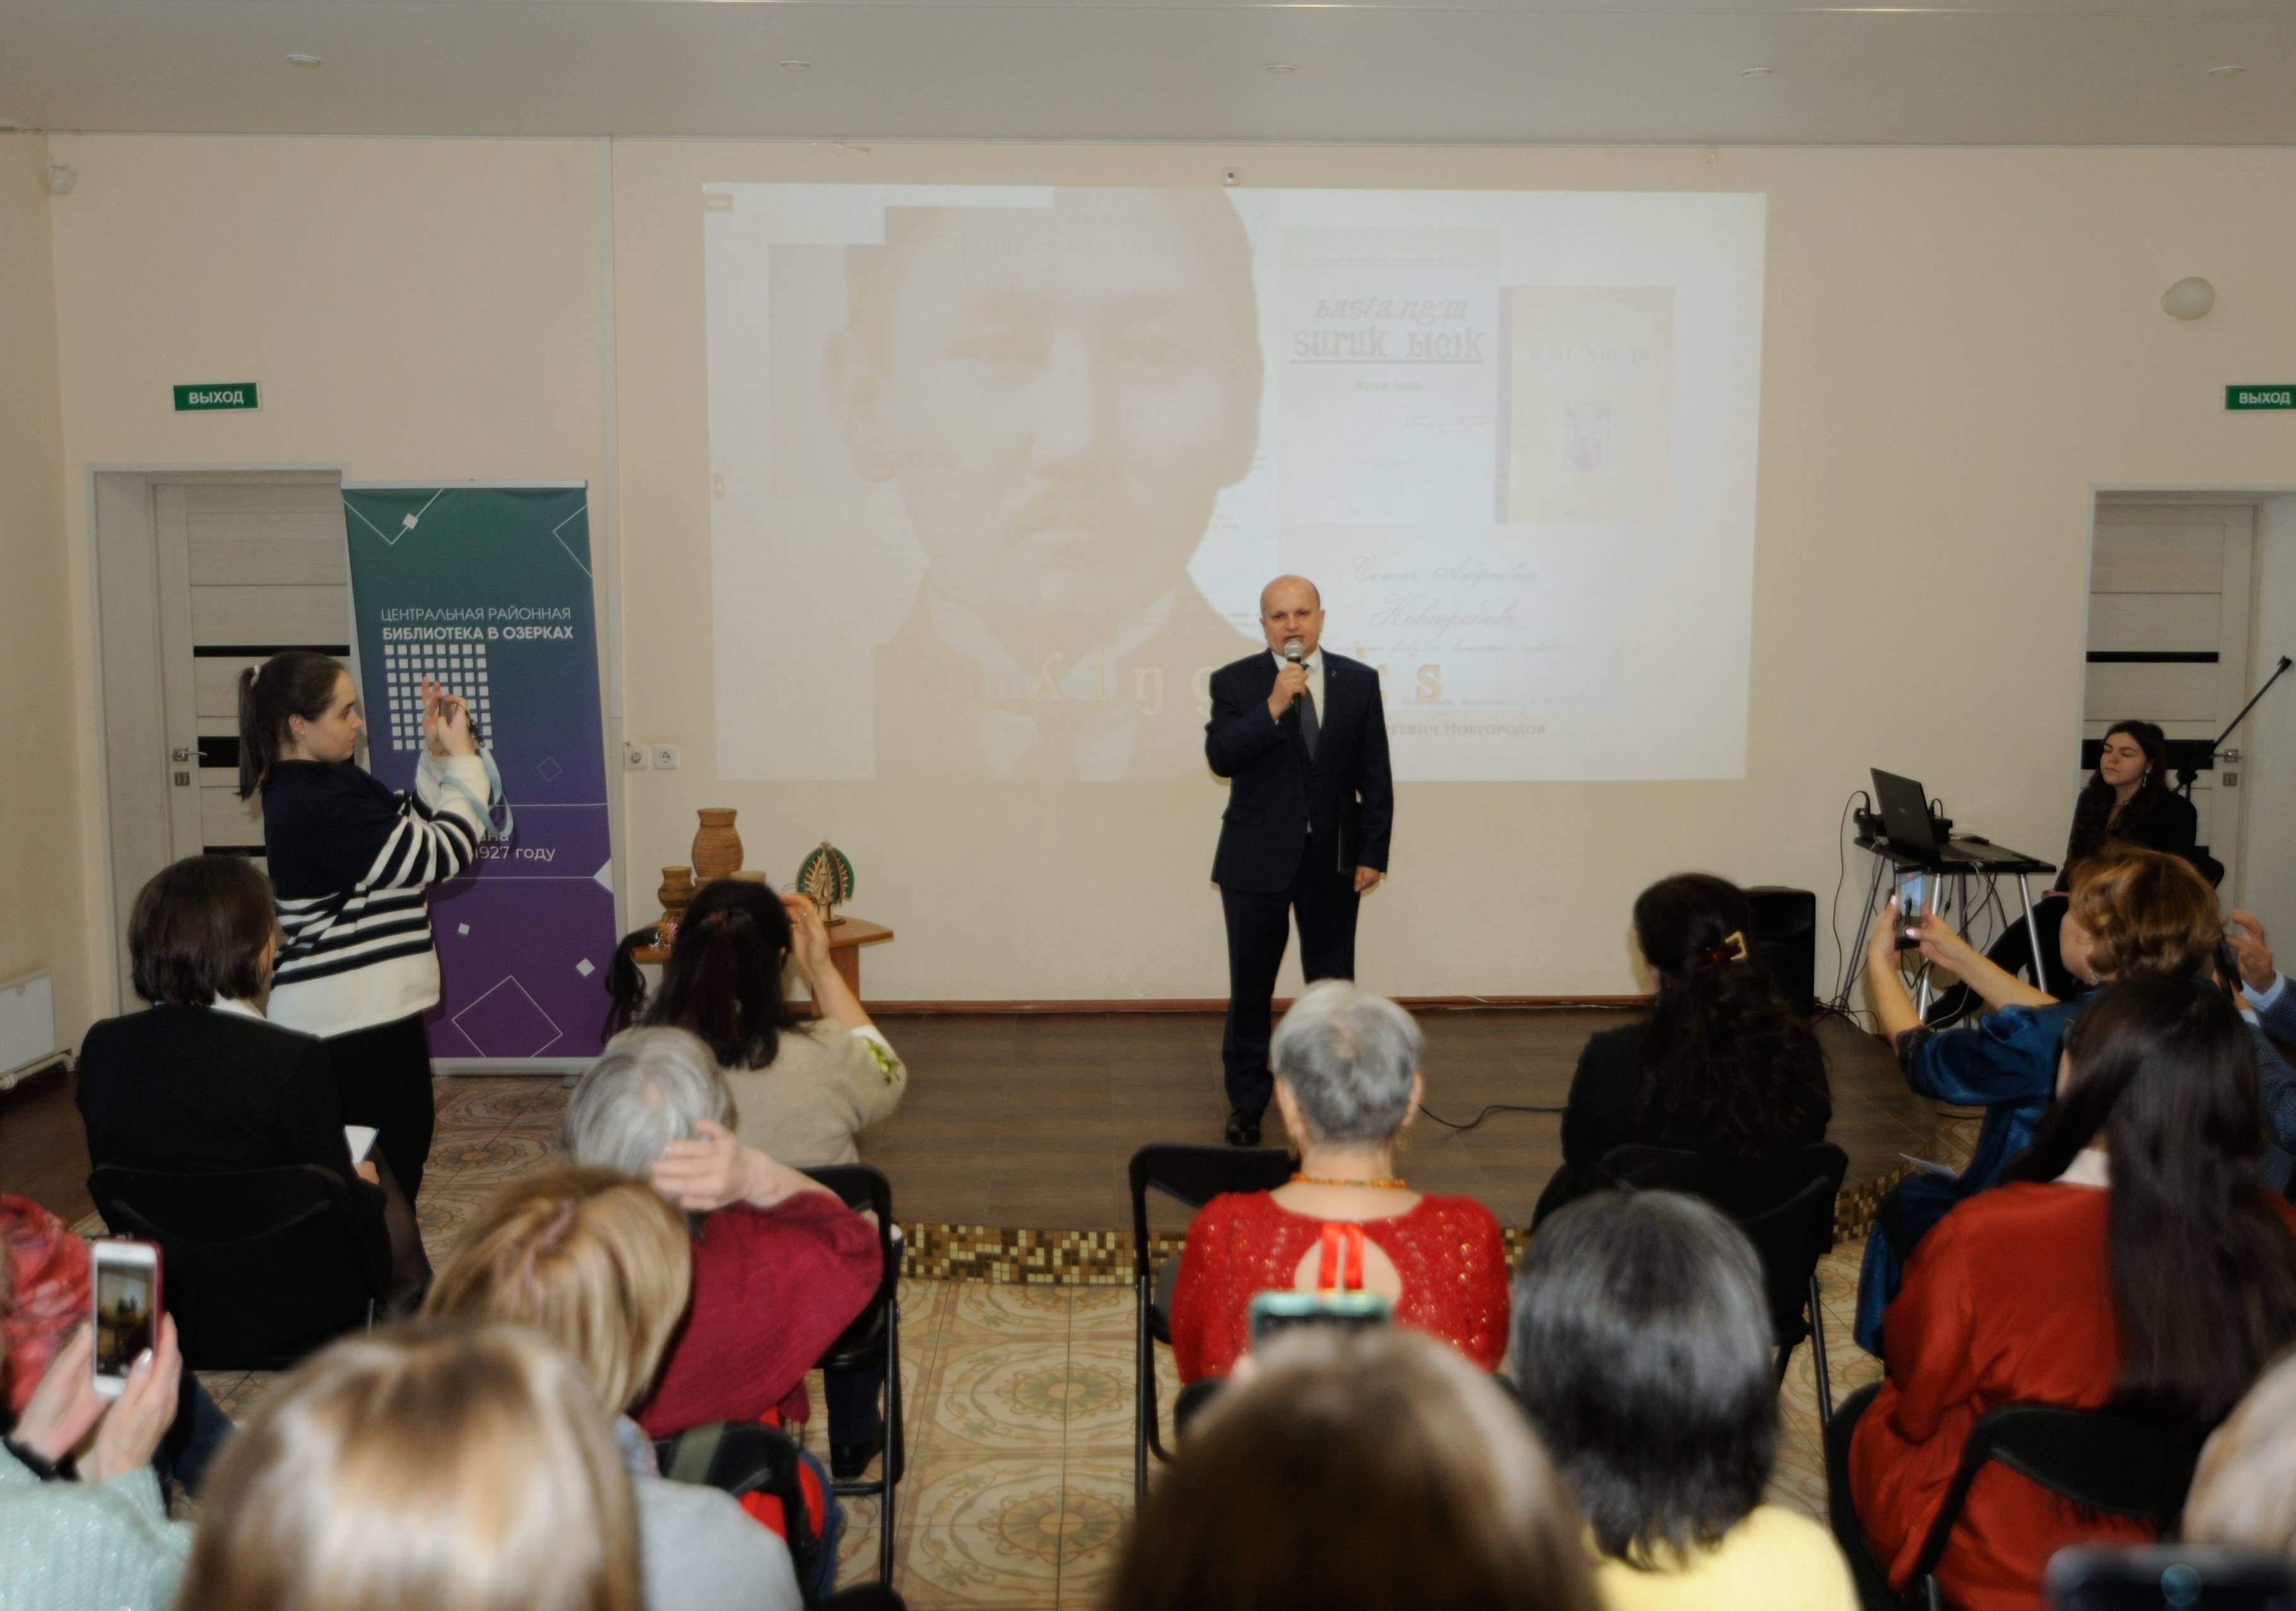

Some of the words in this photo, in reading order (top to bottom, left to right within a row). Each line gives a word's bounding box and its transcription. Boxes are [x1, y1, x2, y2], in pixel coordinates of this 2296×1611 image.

[189, 390, 244, 405] ВЫХОД
[2239, 392, 2291, 405] ВЫХОД
[381, 608, 484, 622] ЦЕНТРАЛЬНАЯ
[488, 606, 571, 620] РАЙОННАЯ
[383, 627, 484, 640] БИБЛИОТЕКА
[488, 627, 499, 640] В
[503, 626, 574, 640] ОЗЕРКАХ
[515, 848, 556, 862] году
